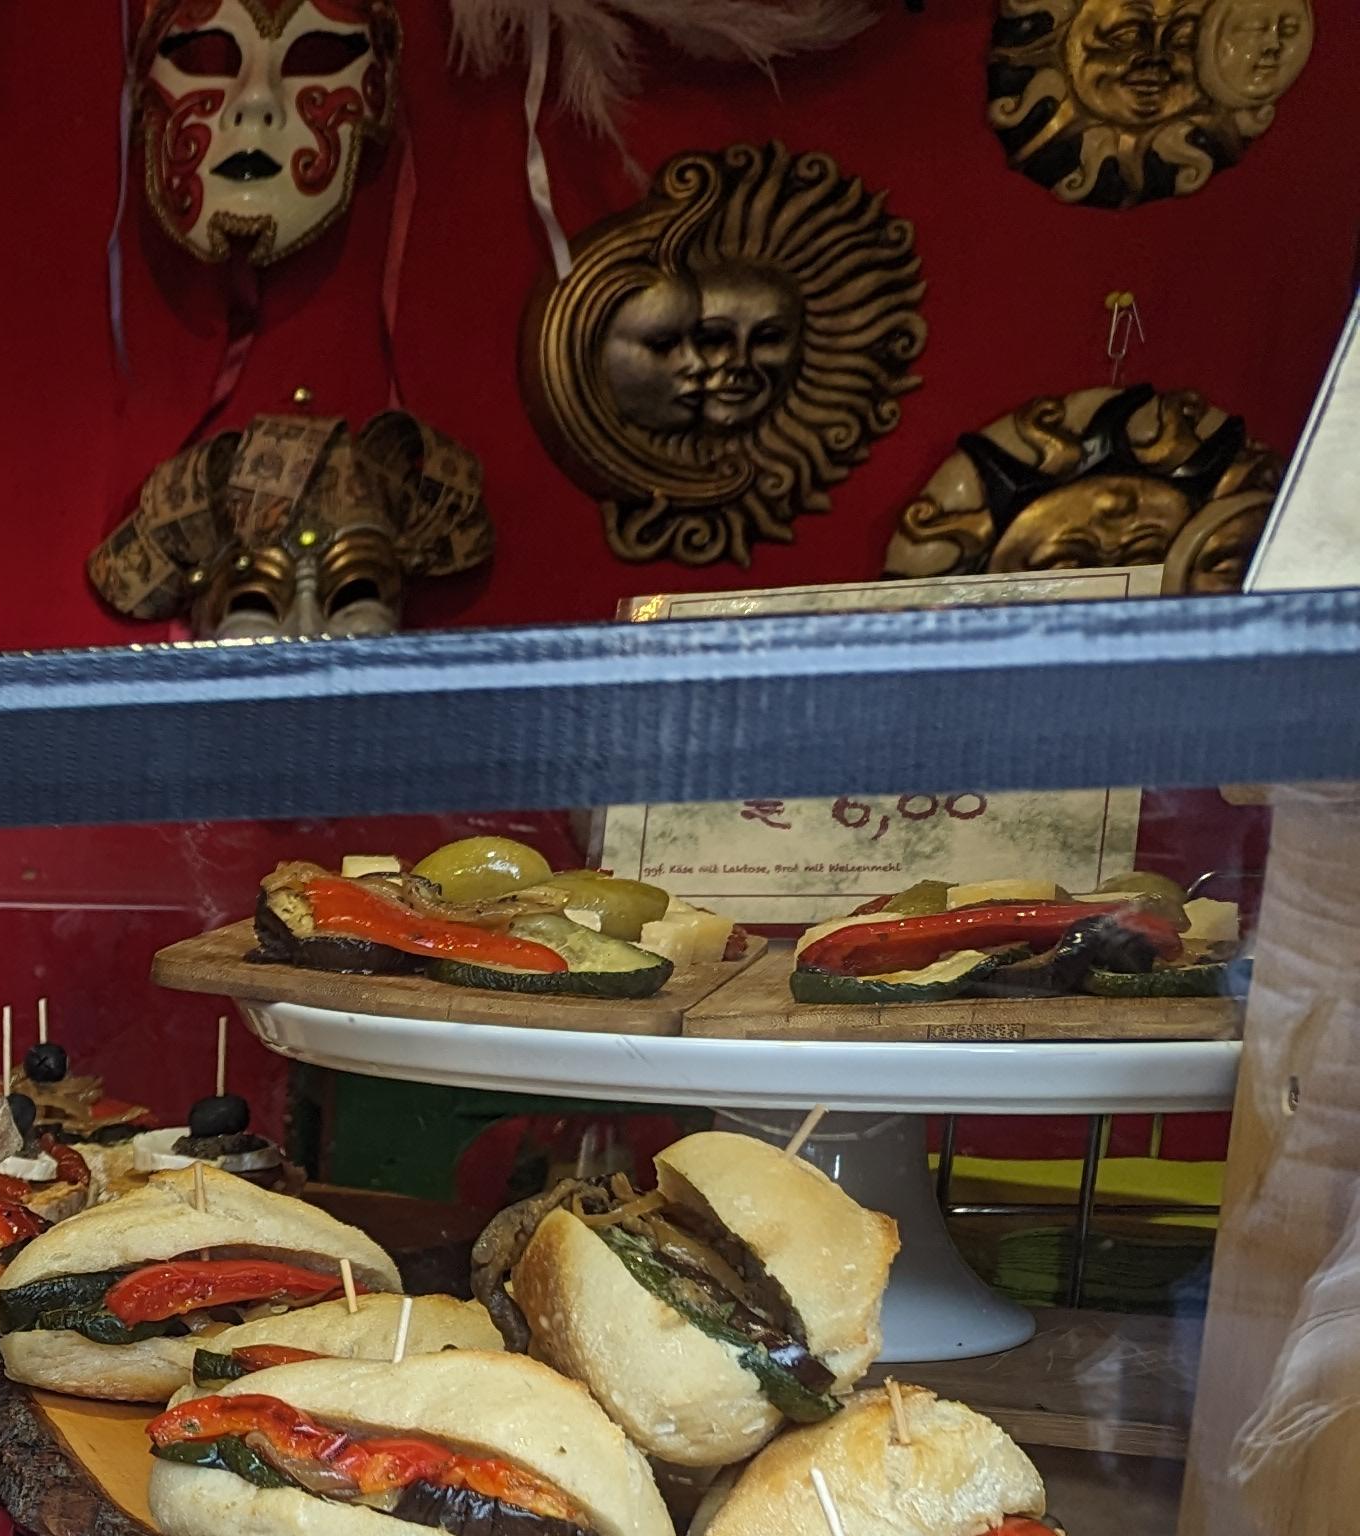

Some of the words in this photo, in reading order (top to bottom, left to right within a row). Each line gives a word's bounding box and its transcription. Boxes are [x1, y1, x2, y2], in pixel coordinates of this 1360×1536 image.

[831, 792, 988, 841] 6,00
[698, 864, 718, 874] mit
[722, 863, 771, 875] Laktose,
[804, 863, 825, 873] mit
